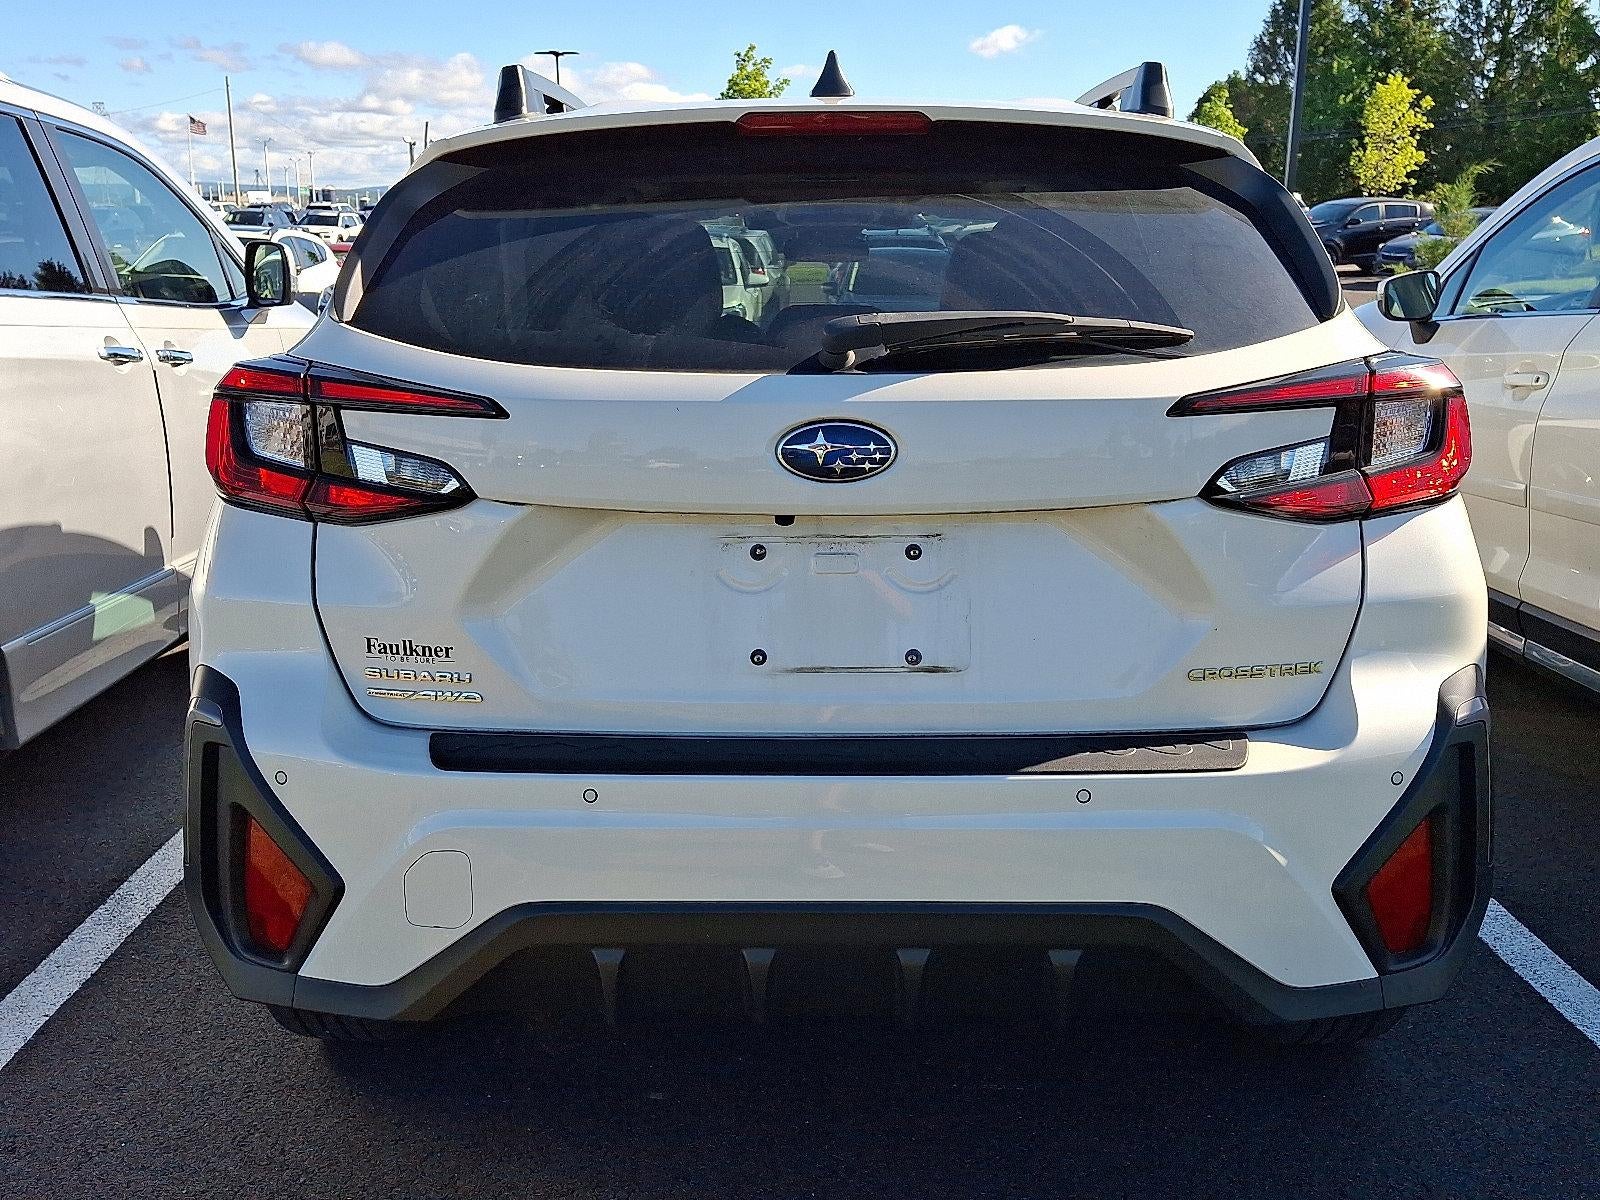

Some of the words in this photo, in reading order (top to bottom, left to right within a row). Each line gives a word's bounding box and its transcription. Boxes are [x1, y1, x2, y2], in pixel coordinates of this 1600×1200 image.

[364, 636, 453, 658] Faulkner
[414, 656, 436, 664] SURE
[364, 666, 473, 683] SUBARU
[1187, 661, 1324, 681] CROSSTREK
[409, 689, 484, 703] AWD
